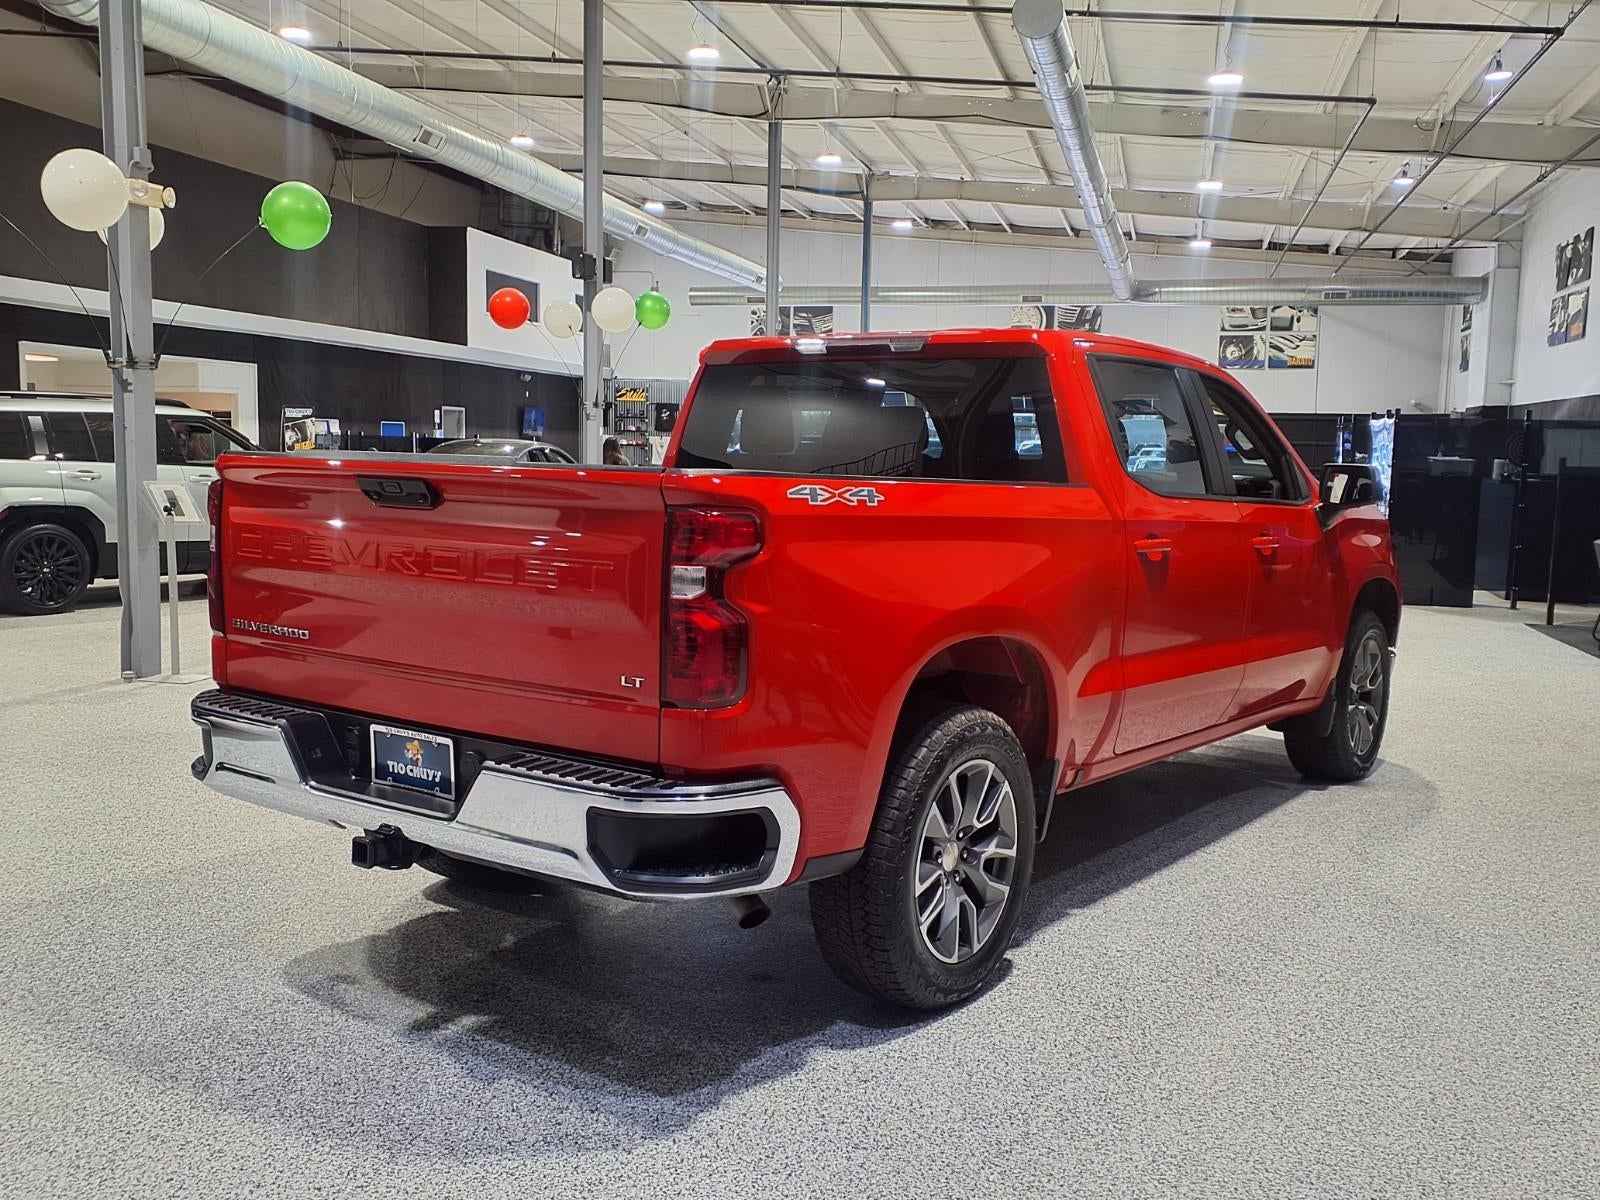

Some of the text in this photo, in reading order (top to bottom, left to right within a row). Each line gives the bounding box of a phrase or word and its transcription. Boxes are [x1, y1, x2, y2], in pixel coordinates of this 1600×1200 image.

[235, 529, 616, 593] CHEVROLET
[232, 618, 310, 640] SILVERADO
[620, 675, 645, 688] LT
[387, 760, 441, 782] TIO CHUY'S
